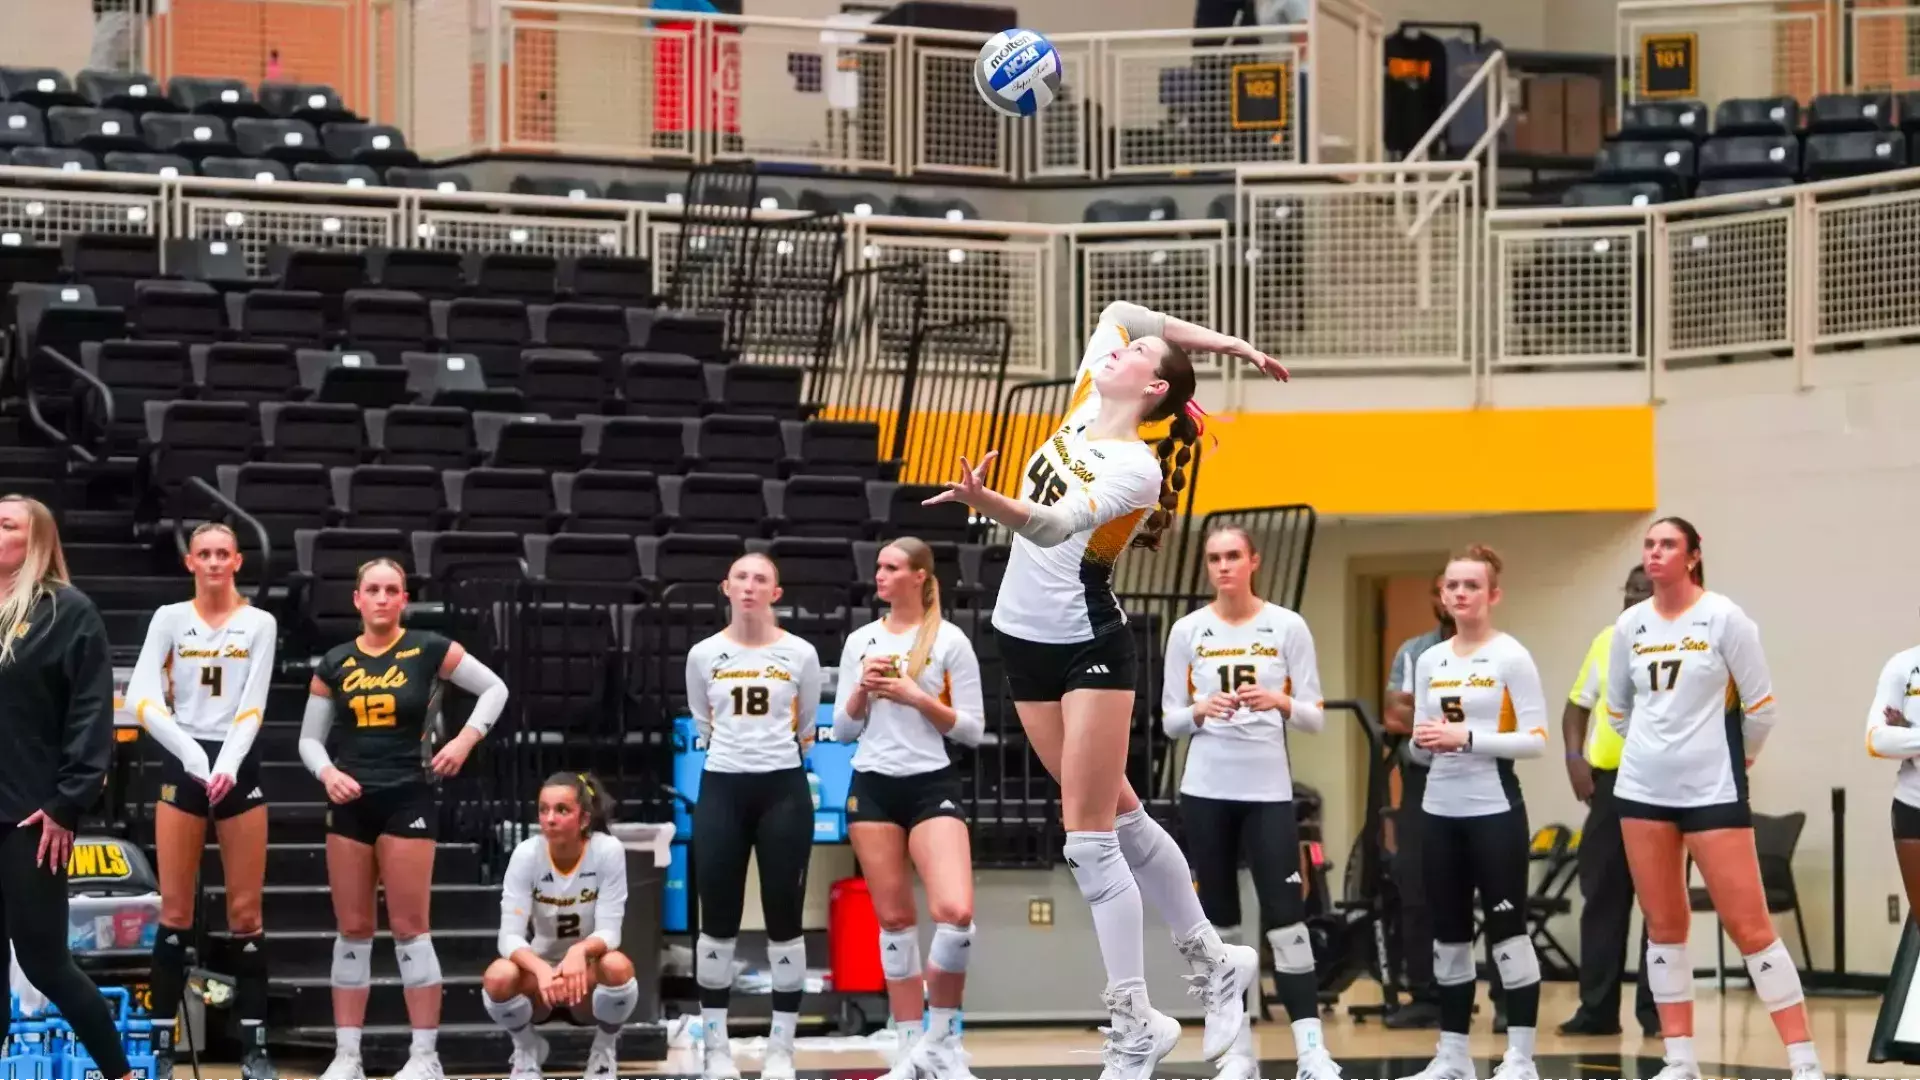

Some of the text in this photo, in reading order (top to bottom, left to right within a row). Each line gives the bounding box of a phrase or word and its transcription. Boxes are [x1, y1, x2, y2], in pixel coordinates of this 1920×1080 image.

[990, 36, 1032, 69] molten
[1003, 44, 1040, 80] NCAA
[1656, 50, 1684, 67] 101
[1246, 81, 1275, 97] 102
[1028, 453, 1068, 507] 46
[200, 666, 222, 697] 4
[342, 665, 408, 693] Owls
[1647, 660, 1682, 692] 17
[348, 693, 397, 728] 12
[730, 686, 769, 716] 18
[1440, 696, 1465, 723] 5
[557, 913, 580, 939] 2
